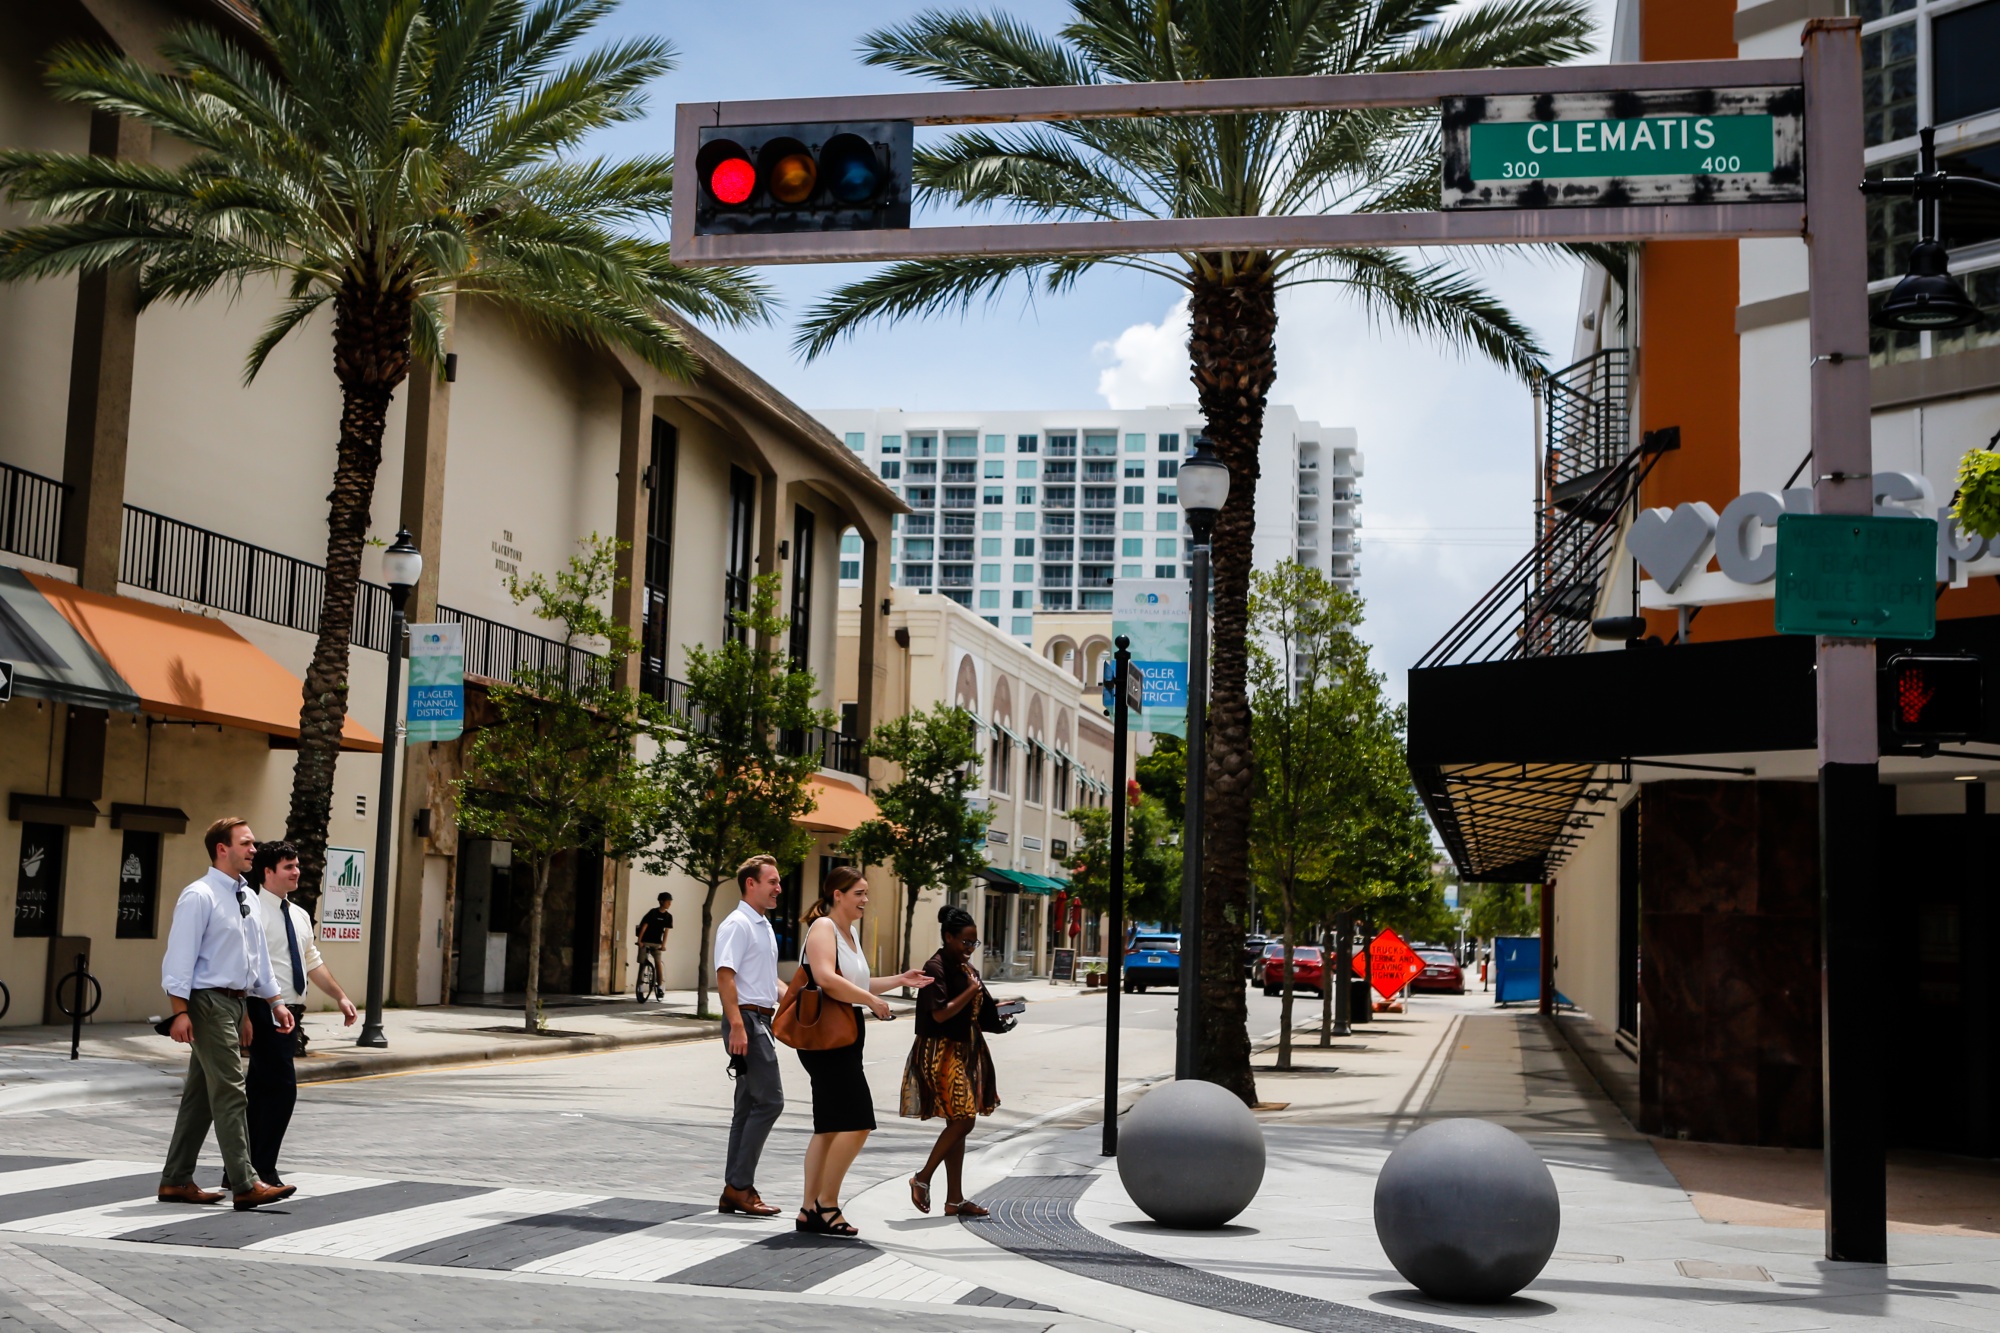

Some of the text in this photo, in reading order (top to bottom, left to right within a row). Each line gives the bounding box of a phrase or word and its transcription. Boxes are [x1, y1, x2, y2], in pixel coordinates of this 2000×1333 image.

[1527, 118, 1716, 154] CLEMATIS
[1502, 155, 1741, 178] 300 400
[1866, 529, 1923, 550] PALM
[1821, 552, 1891, 576] BEACH
[1784, 577, 1925, 605] POLICE DEPT
[1141, 668, 1175, 679] AGLER
[417, 690, 453, 699] FLAGLER
[1142, 691, 1175, 702] TRICT
[413, 699, 458, 708] FINANCIAL
[416, 708, 454, 717] DISTRICT
[333, 908, 360, 920] 659-5554
[322, 927, 360, 939] FOR LEASE
[1372, 946, 1405, 954] TRUCKS
[1361, 954, 1395, 962] ETERING
[1372, 963, 1403, 971] LEAVING
